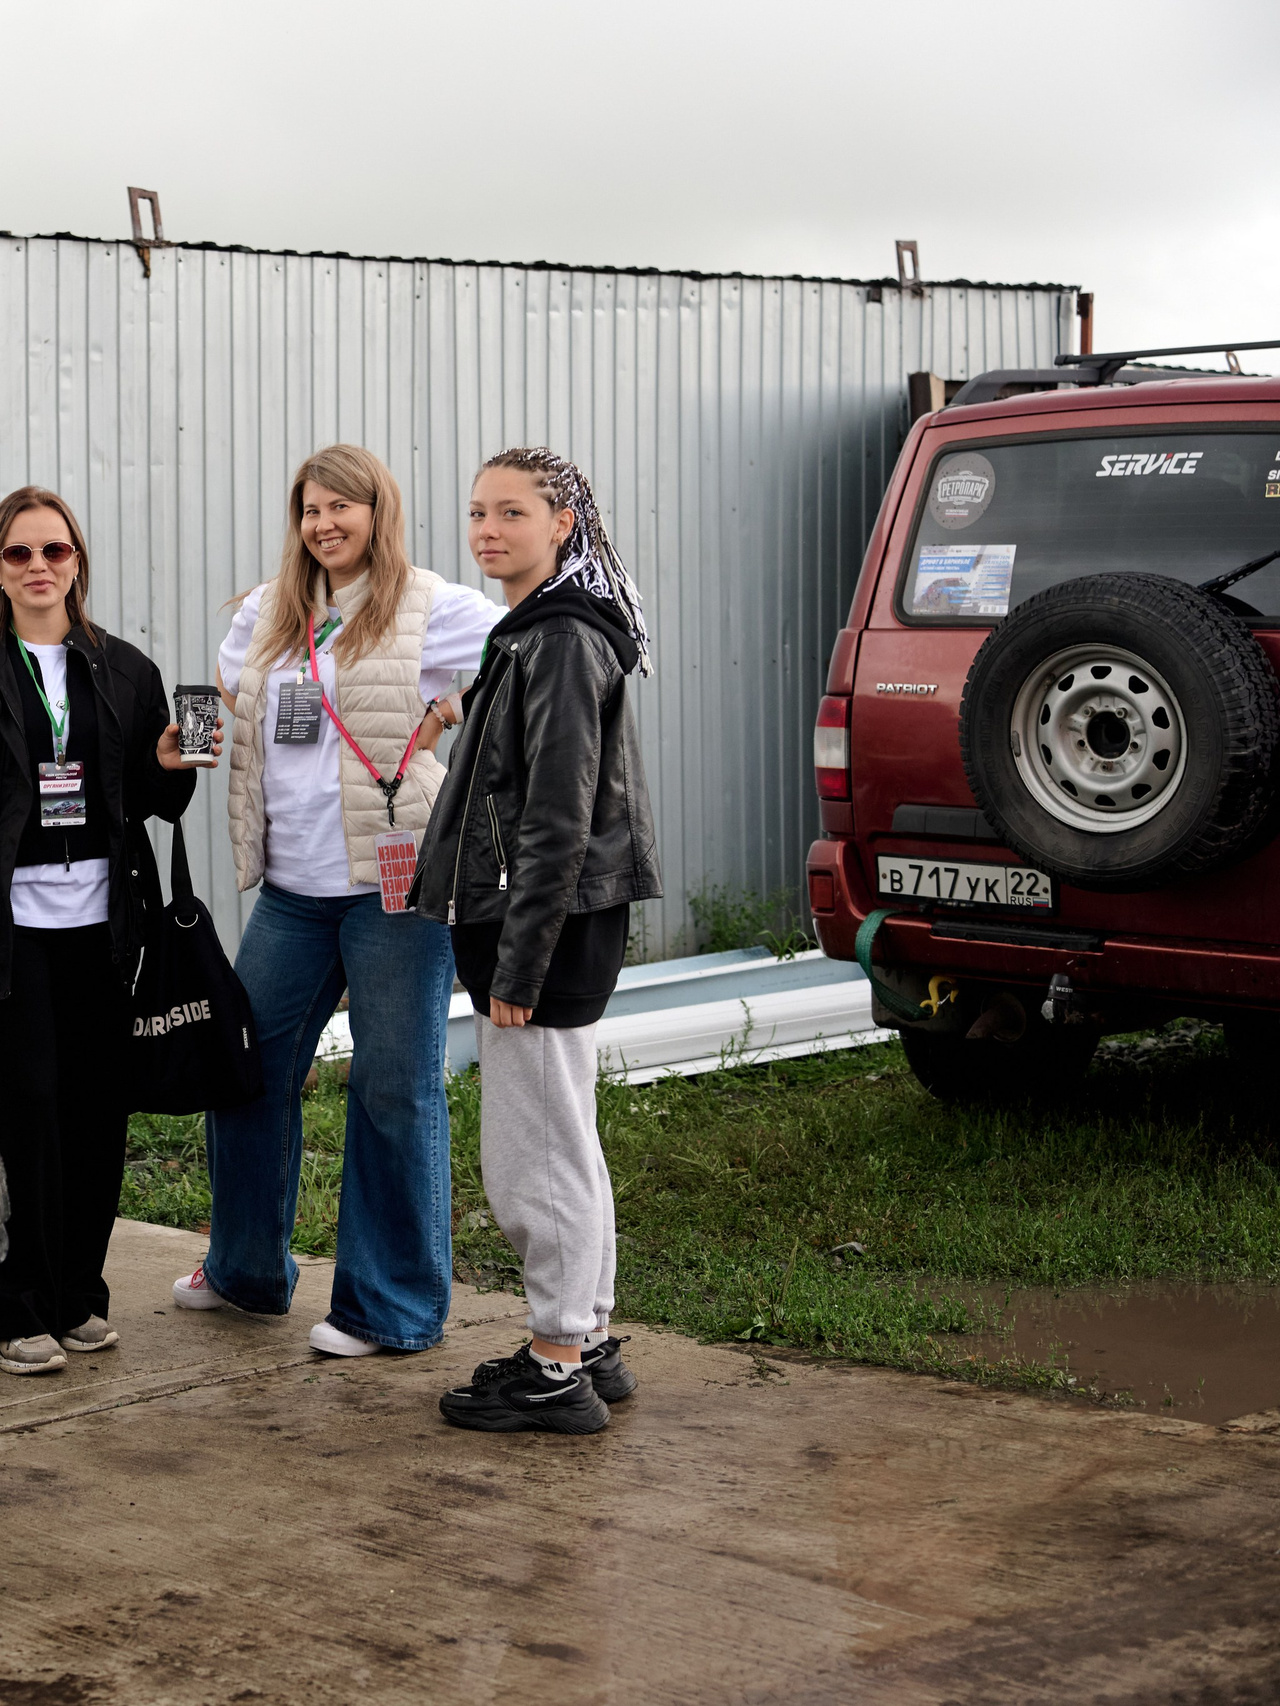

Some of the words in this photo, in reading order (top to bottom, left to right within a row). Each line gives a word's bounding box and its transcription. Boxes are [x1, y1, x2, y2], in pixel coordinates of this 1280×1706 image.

[942, 481, 985, 498] РЕТРОПАРК
[876, 683, 938, 695] PATRIOT
[378, 843, 416, 862] WOMEN
[382, 876, 413, 895] OMEN
[1010, 871, 1040, 896] 22
[1010, 896, 1032, 906] RUS
